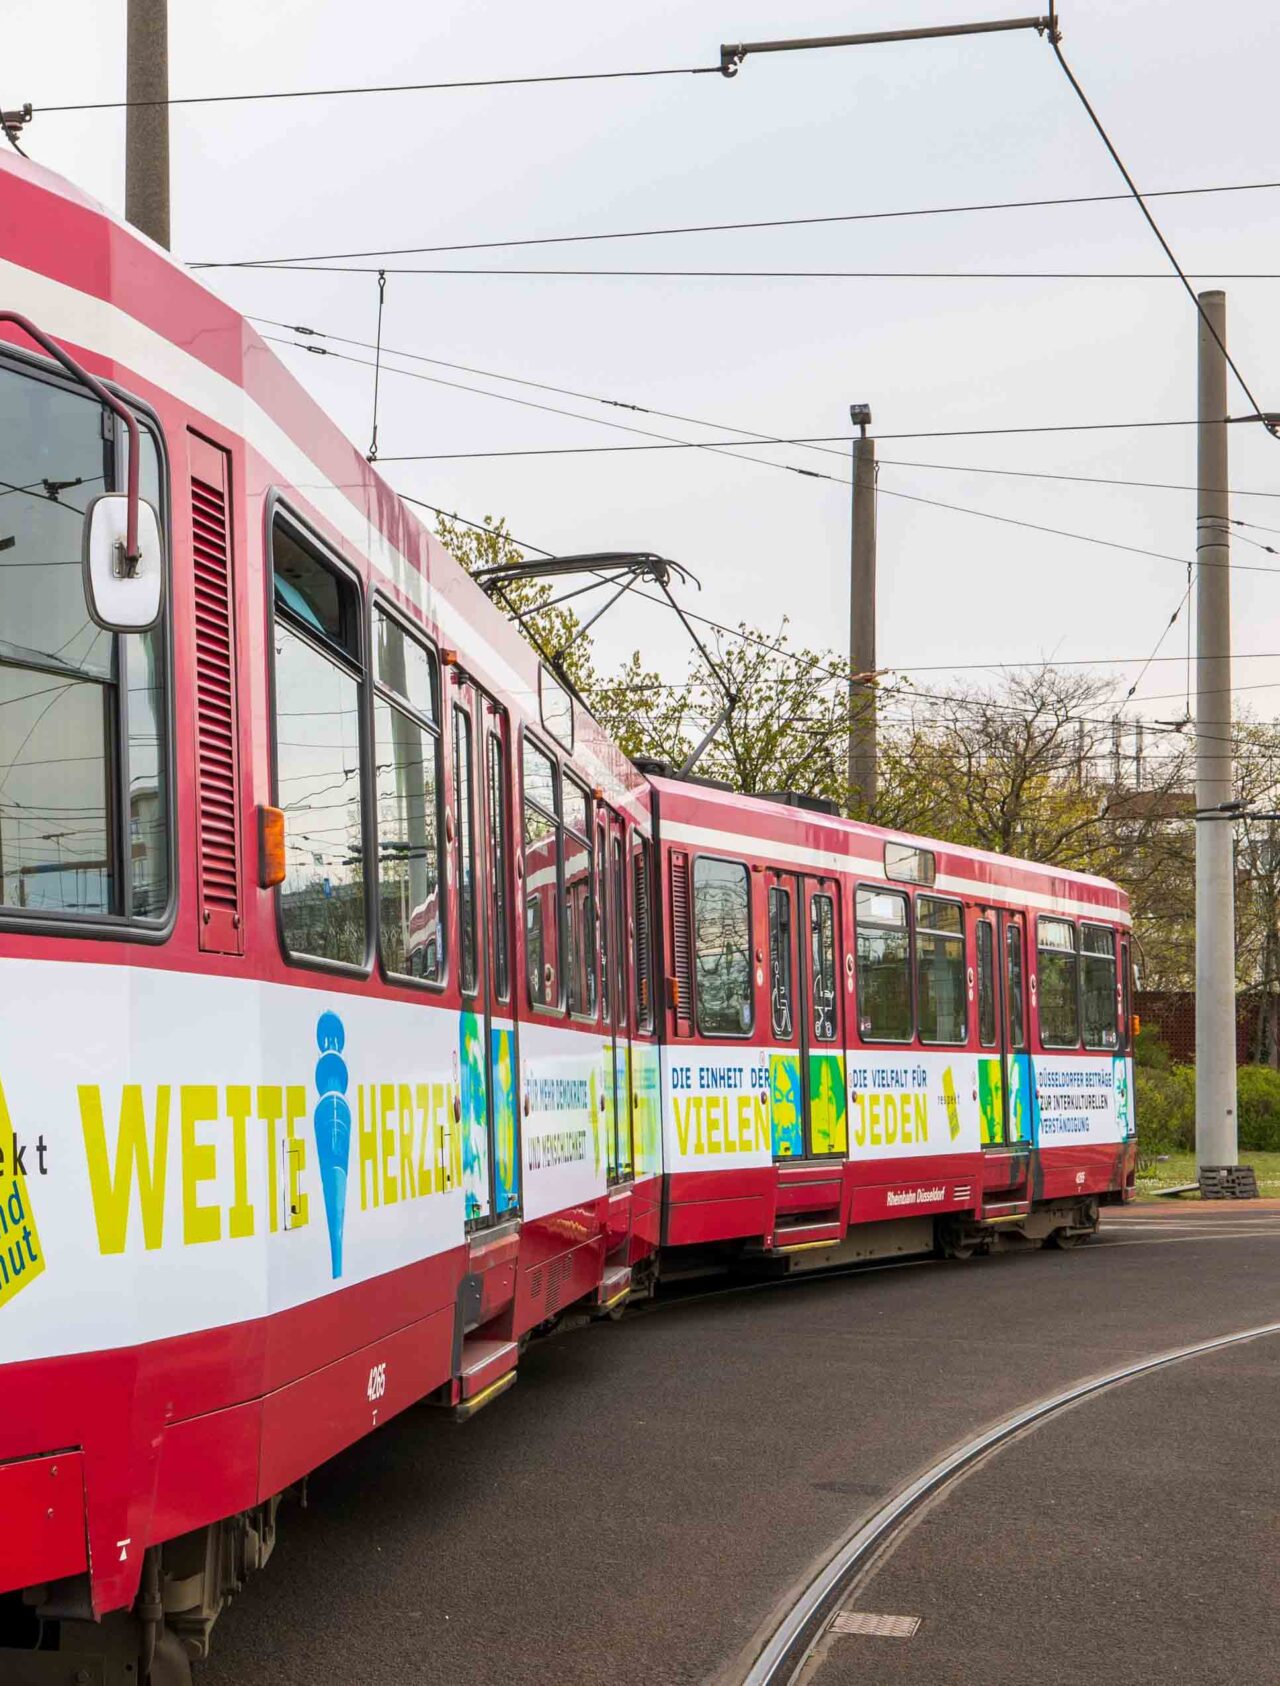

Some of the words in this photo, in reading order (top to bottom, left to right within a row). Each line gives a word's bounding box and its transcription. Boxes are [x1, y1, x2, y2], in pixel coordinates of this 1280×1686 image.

[672, 1067, 691, 1089] DIE
[699, 1067, 743, 1089] EINHEIT
[751, 1067, 770, 1089] DER
[853, 1069, 867, 1088] DIE
[872, 1069, 908, 1088] VIELFALT
[912, 1064, 927, 1088] FÜR
[1039, 1067, 1083, 1088] DÜSSELDORFER
[1085, 1068, 1112, 1088] BEITRÄGE
[673, 1095, 771, 1156] VIELEN
[854, 1092, 928, 1147] JEDEN
[77, 1084, 309, 1255] WEITE
[358, 1083, 462, 1211] HERZEN
[886, 1188, 916, 1206] Rheinbahn
[916, 1185, 946, 1203] Düsseldorf
[367, 1362, 387, 1402] 4265
